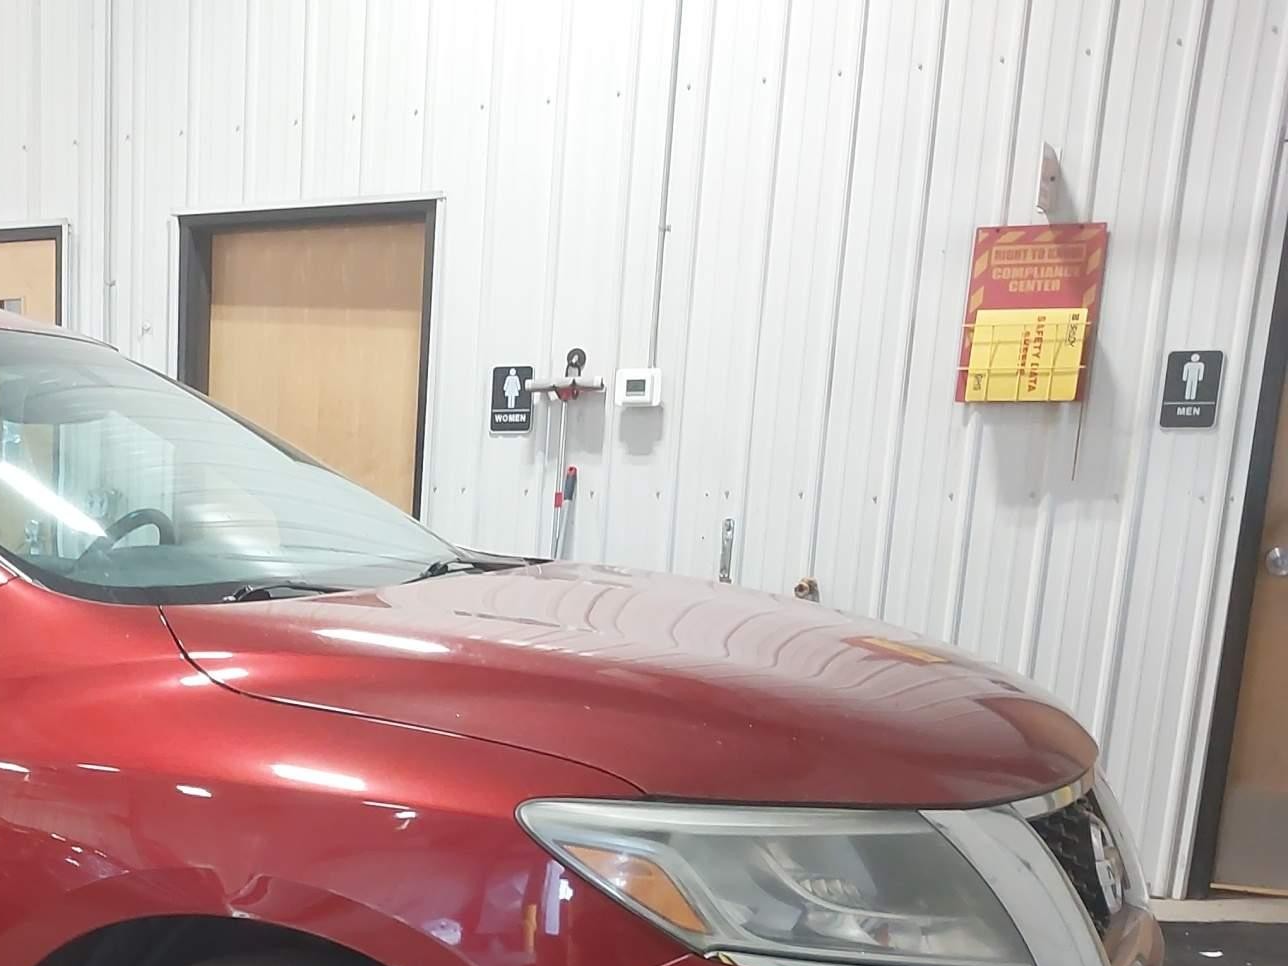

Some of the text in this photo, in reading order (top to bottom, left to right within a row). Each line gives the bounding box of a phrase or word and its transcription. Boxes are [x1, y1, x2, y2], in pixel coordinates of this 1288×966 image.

[992, 264, 1082, 280] COMPLIANCE
[1008, 279, 1061, 293] CENTER
[1027, 315, 1047, 393] SAFETY DATA
[494, 413, 527, 423] WOMEN
[1176, 406, 1201, 416] MEN
